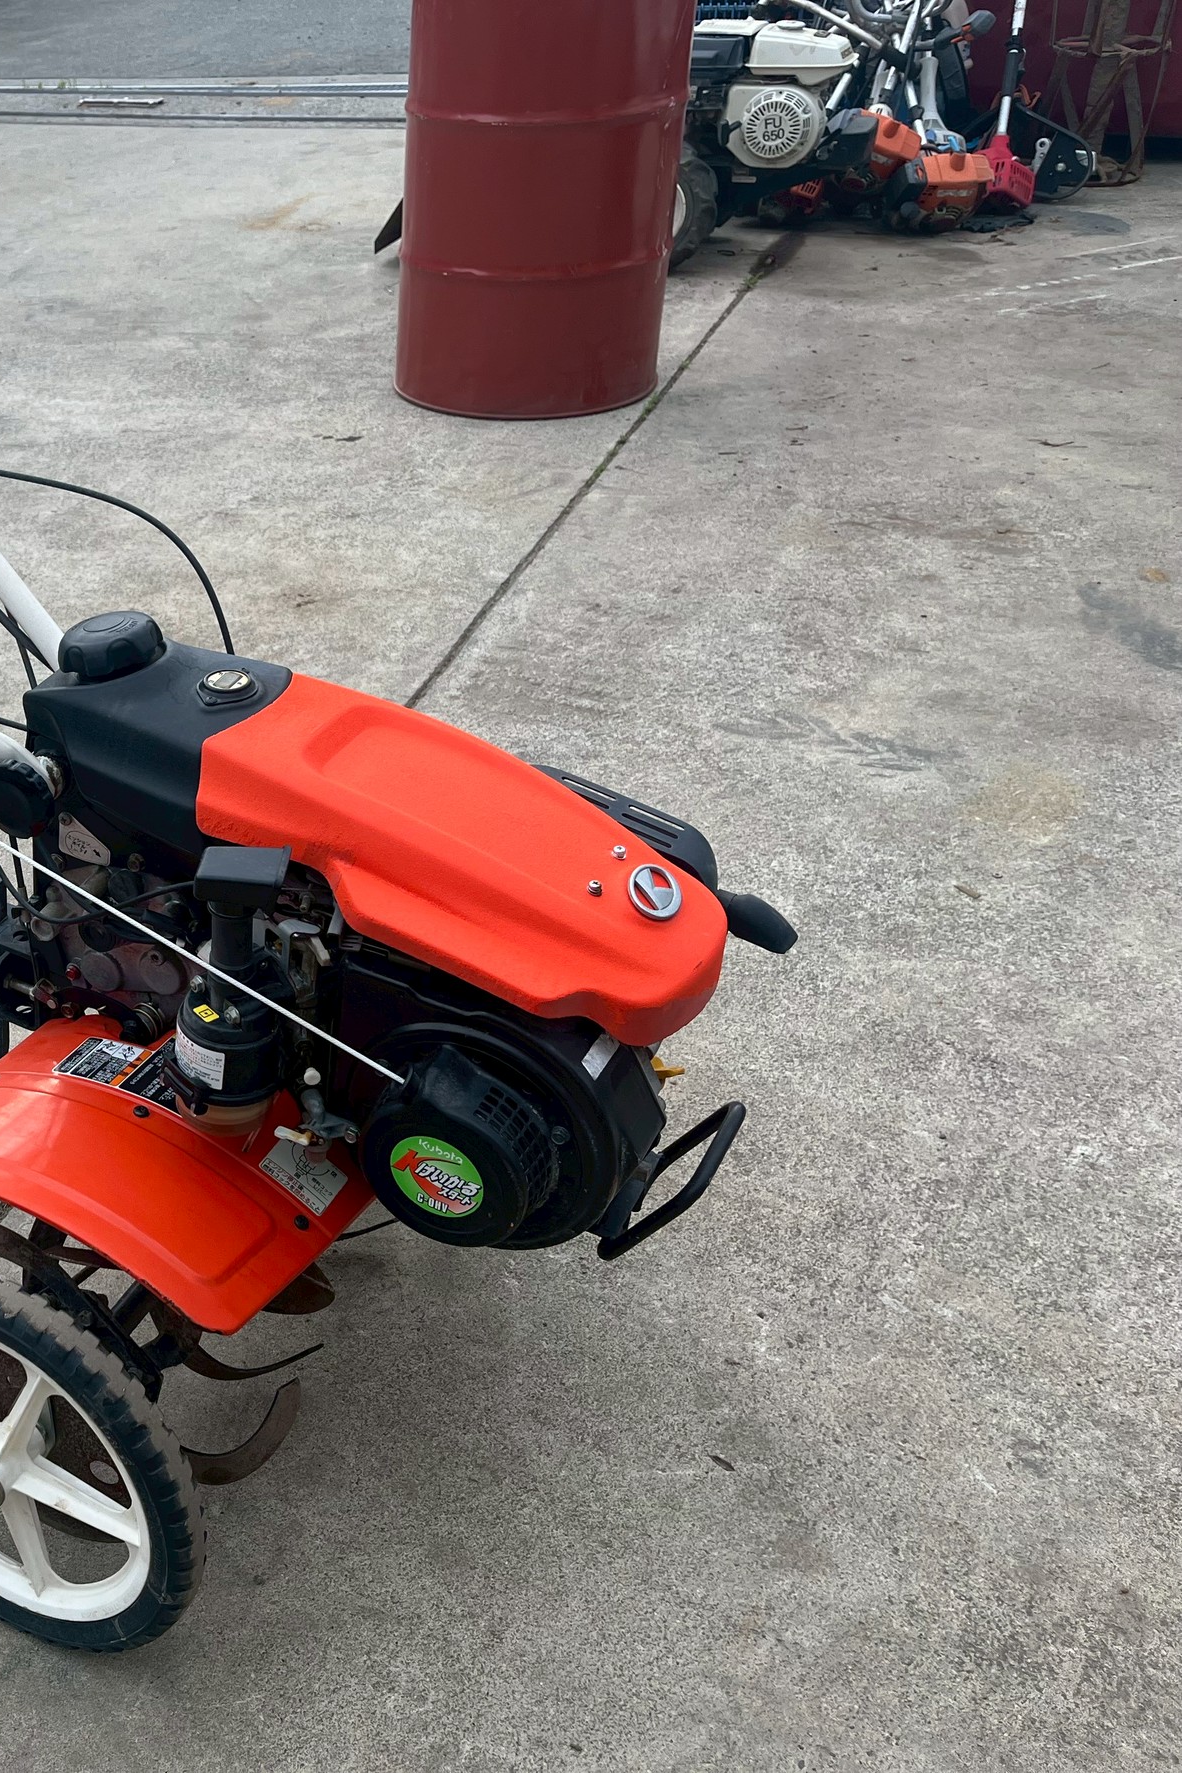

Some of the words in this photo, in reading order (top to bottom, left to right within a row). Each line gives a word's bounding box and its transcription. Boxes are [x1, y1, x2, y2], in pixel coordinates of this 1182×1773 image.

[764, 116, 783, 129] FU
[762, 128, 785, 142] 650
[418, 1138, 463, 1164] Kubota
[438, 1186, 471, 1206] スタート
